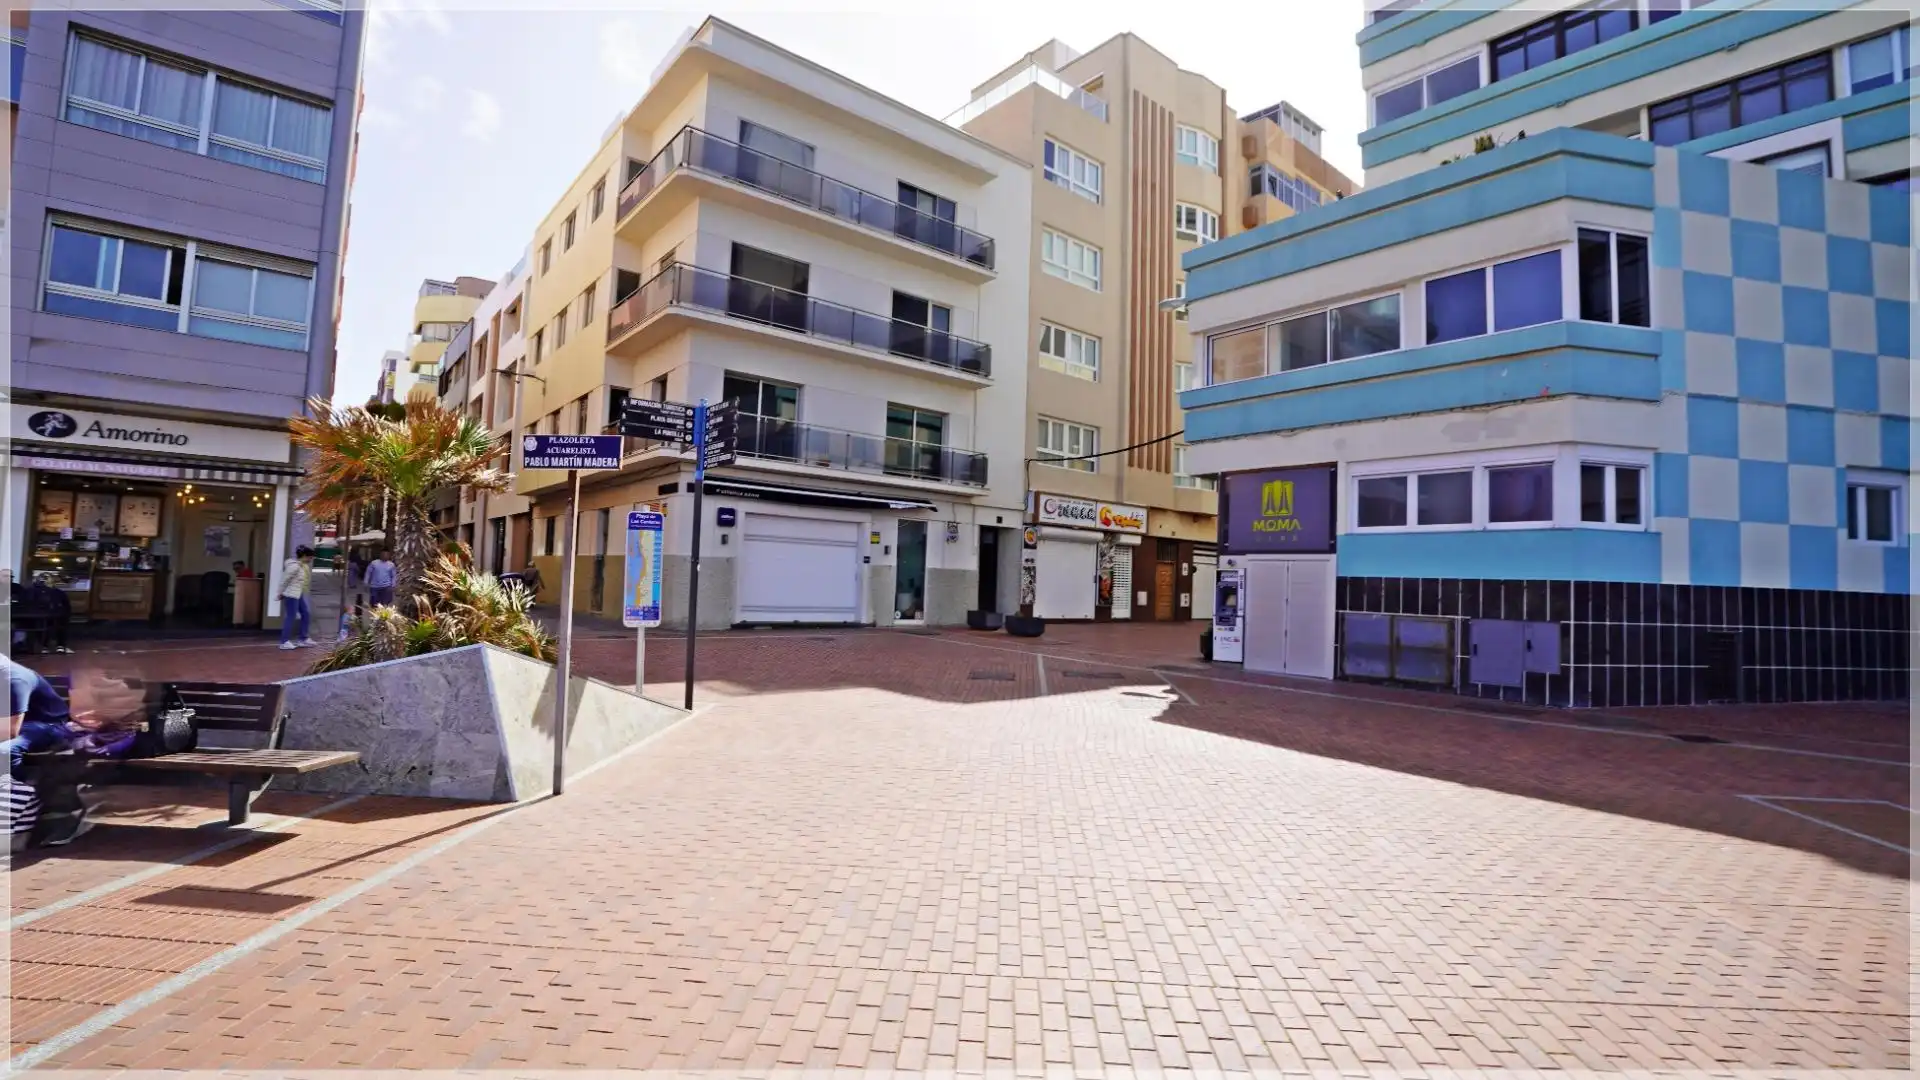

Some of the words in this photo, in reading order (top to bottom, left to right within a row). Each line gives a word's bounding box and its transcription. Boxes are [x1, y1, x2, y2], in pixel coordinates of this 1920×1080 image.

[82, 420, 189, 446] Amorino
[549, 436, 595, 444] PLAZOLETA
[546, 447, 597, 455] ACUARELISTA
[524, 456, 550, 467] PABLO
[551, 455, 582, 467] MARTÍN
[584, 457, 618, 467] MADERA
[1252, 518, 1303, 532] MOMA
